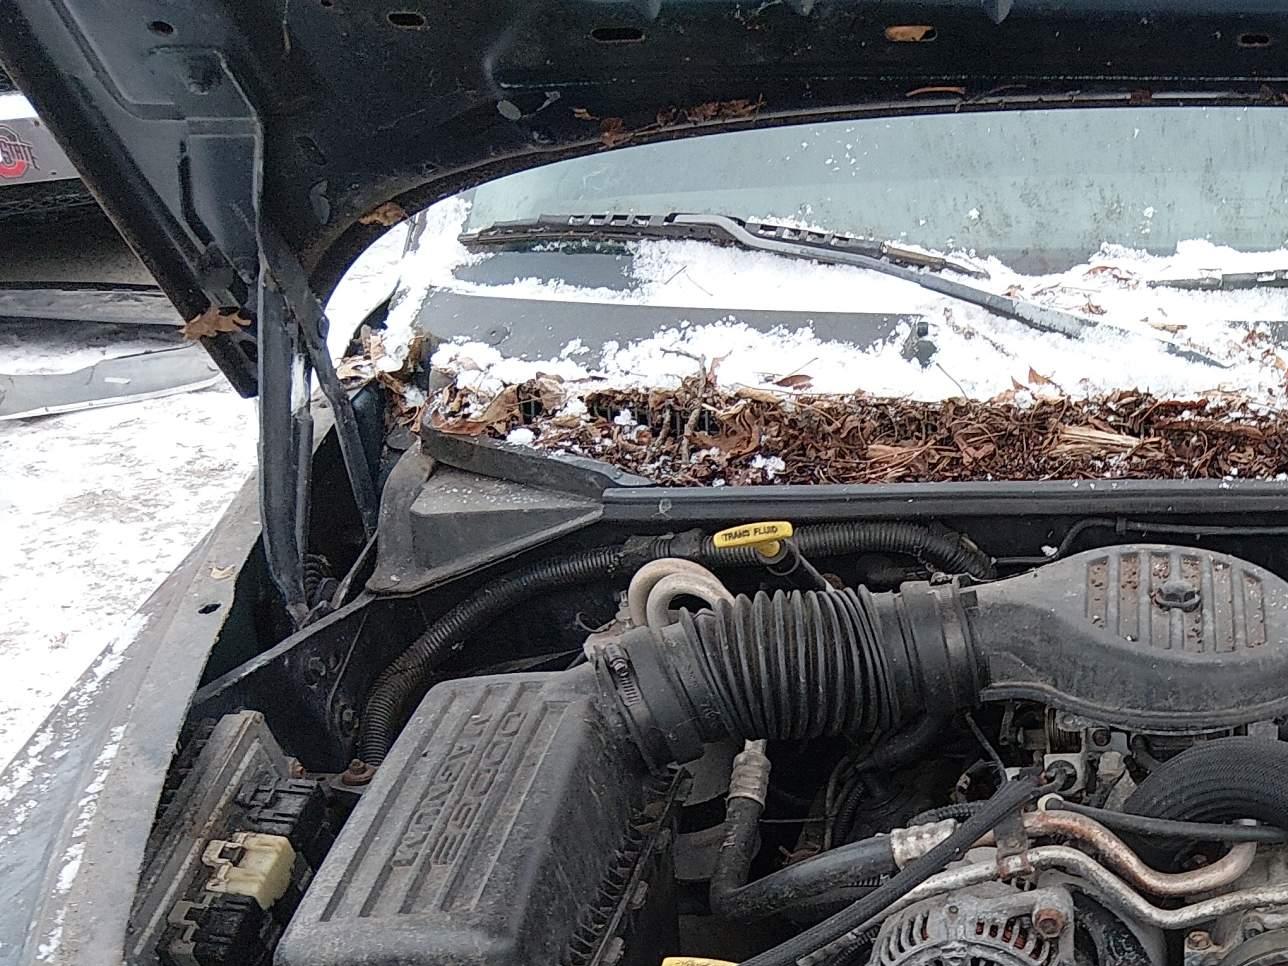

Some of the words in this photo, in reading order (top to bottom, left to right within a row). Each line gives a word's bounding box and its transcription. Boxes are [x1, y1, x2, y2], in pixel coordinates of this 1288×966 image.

[723, 529, 750, 542] TRANS
[753, 525, 779, 537] FLUID
[391, 713, 494, 867] MAGNUM
[429, 711, 529, 866] DODGE
